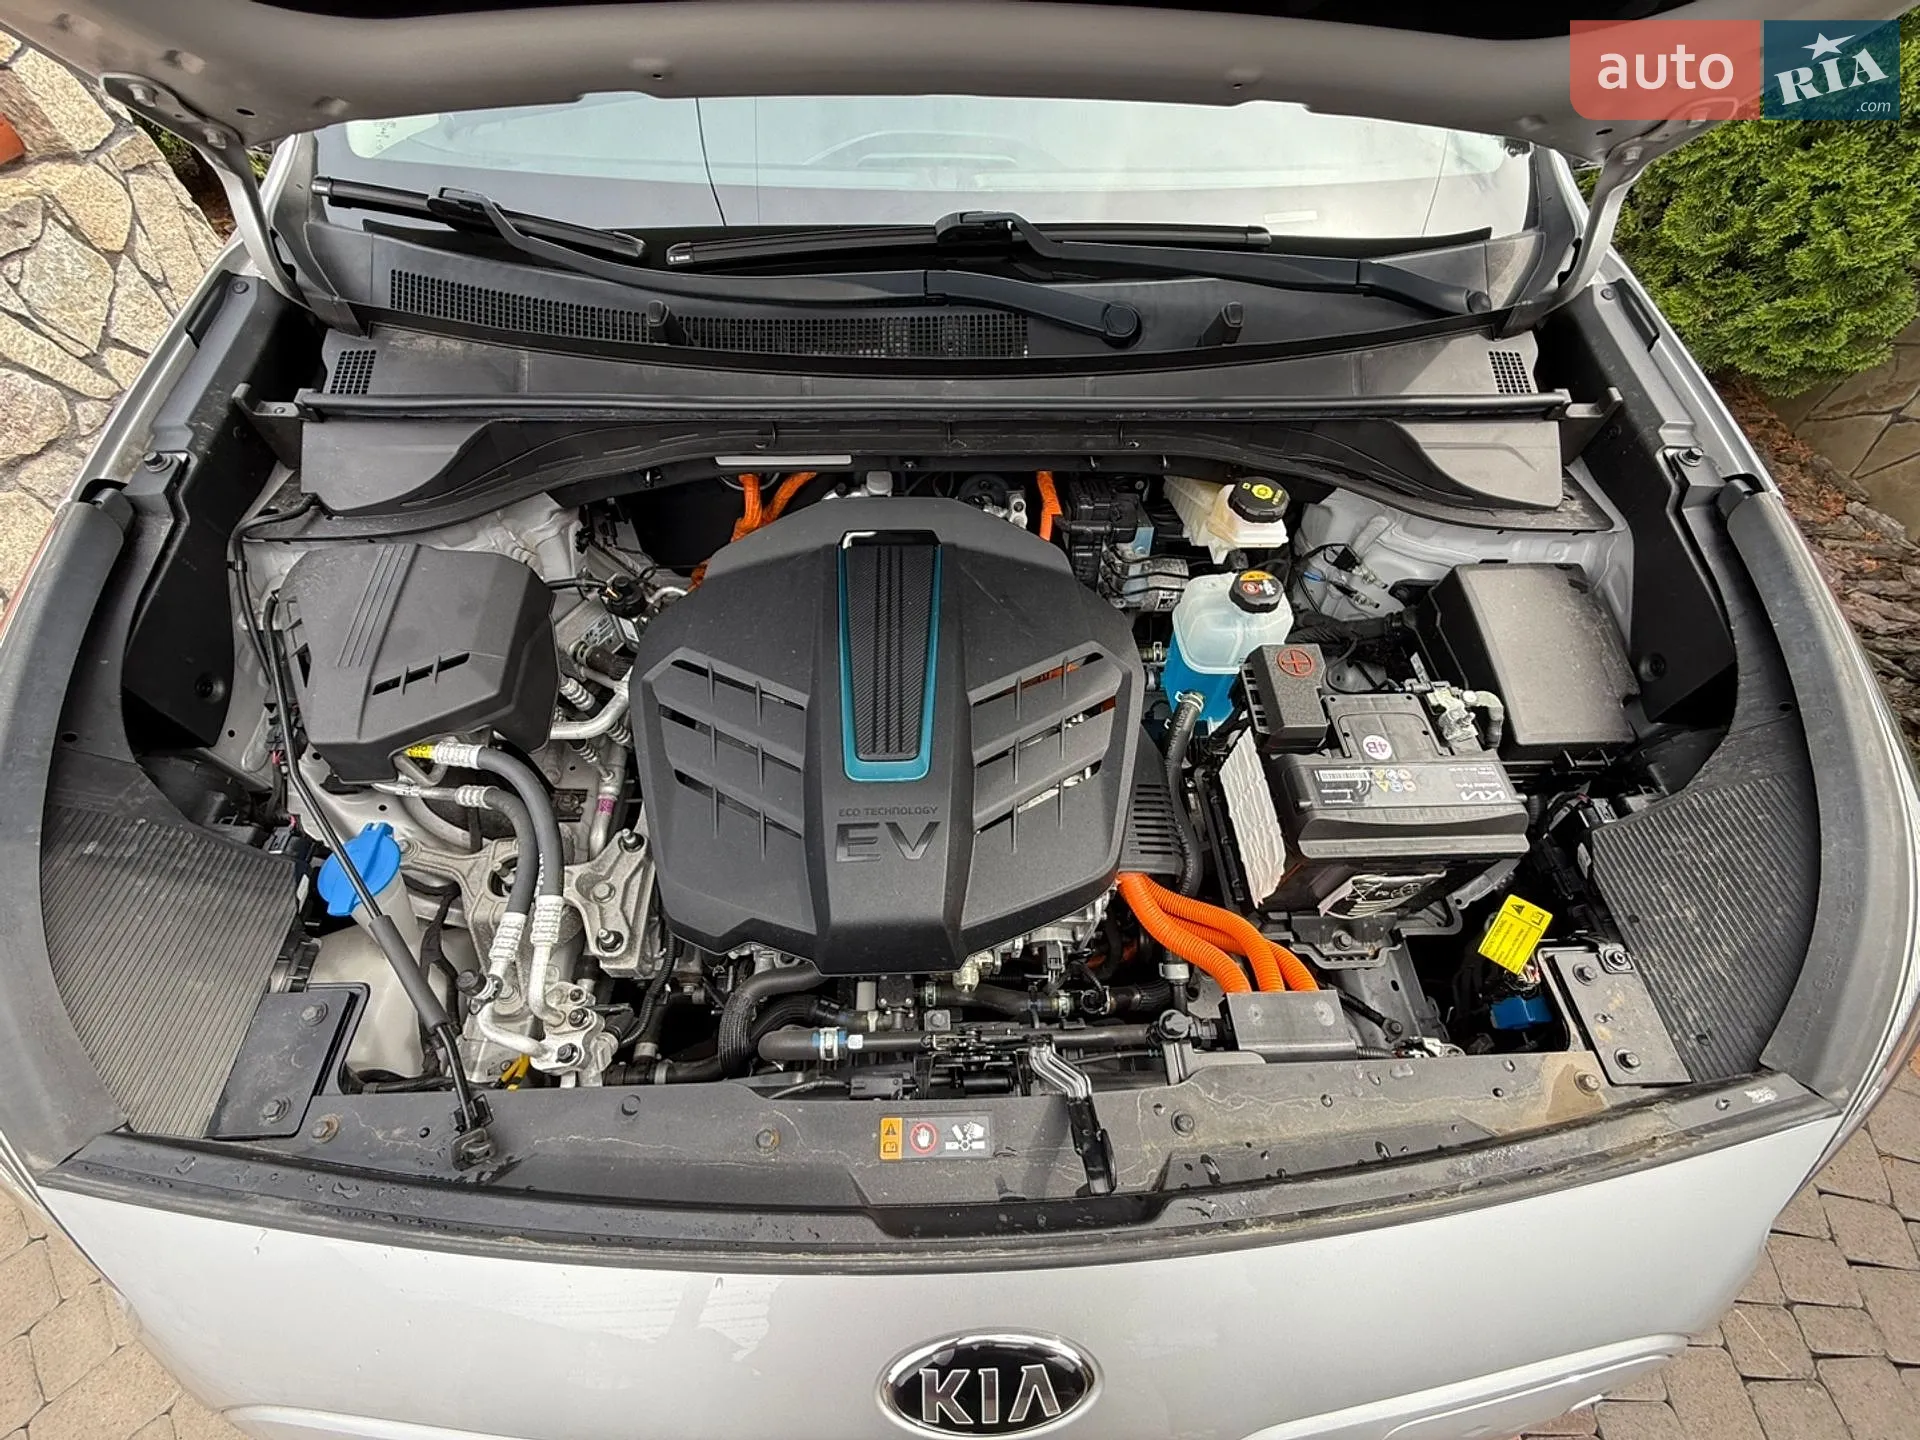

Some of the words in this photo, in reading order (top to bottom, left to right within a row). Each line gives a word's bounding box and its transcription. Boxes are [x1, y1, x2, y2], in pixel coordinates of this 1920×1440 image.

[1365, 741, 1388, 754] 4B
[838, 807, 861, 817] ECO
[864, 806, 939, 816] TECHNOLOGY
[835, 820, 941, 864] EV
[918, 1363, 1061, 1425] KIA
